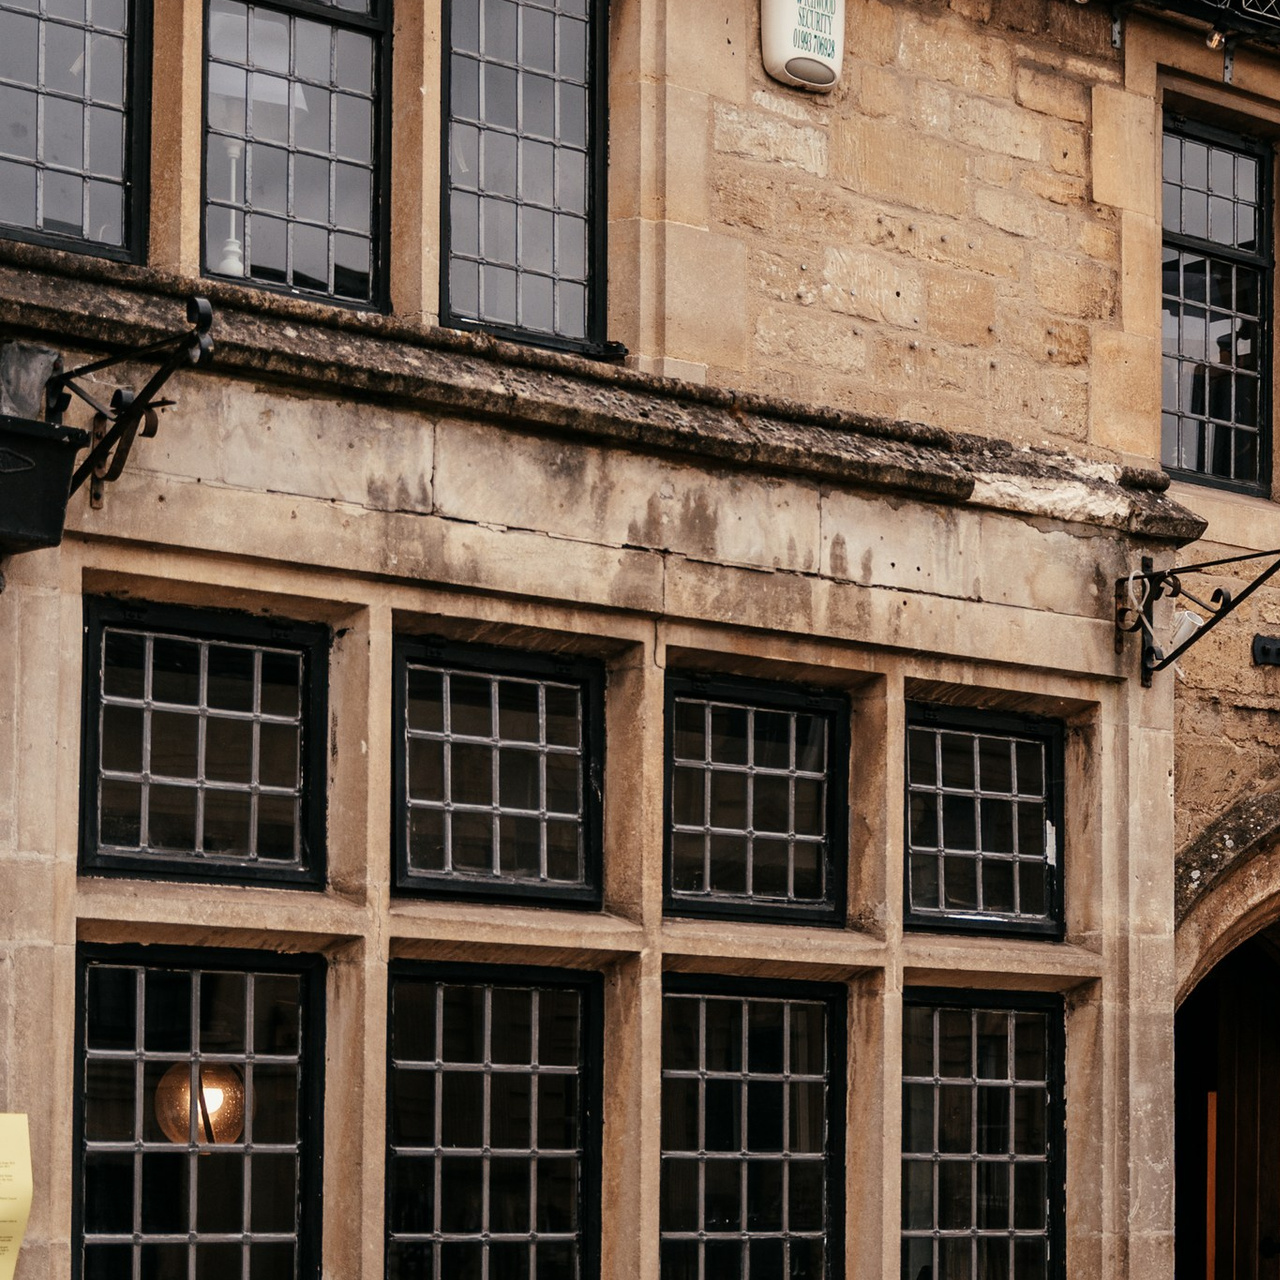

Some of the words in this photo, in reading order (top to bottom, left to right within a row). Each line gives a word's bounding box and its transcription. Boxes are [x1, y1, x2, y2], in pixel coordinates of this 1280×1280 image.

[798, 6, 834, 35] SECURITY
[793, 28, 812, 52] 01993
[813, 34, 836, 59] 706928
